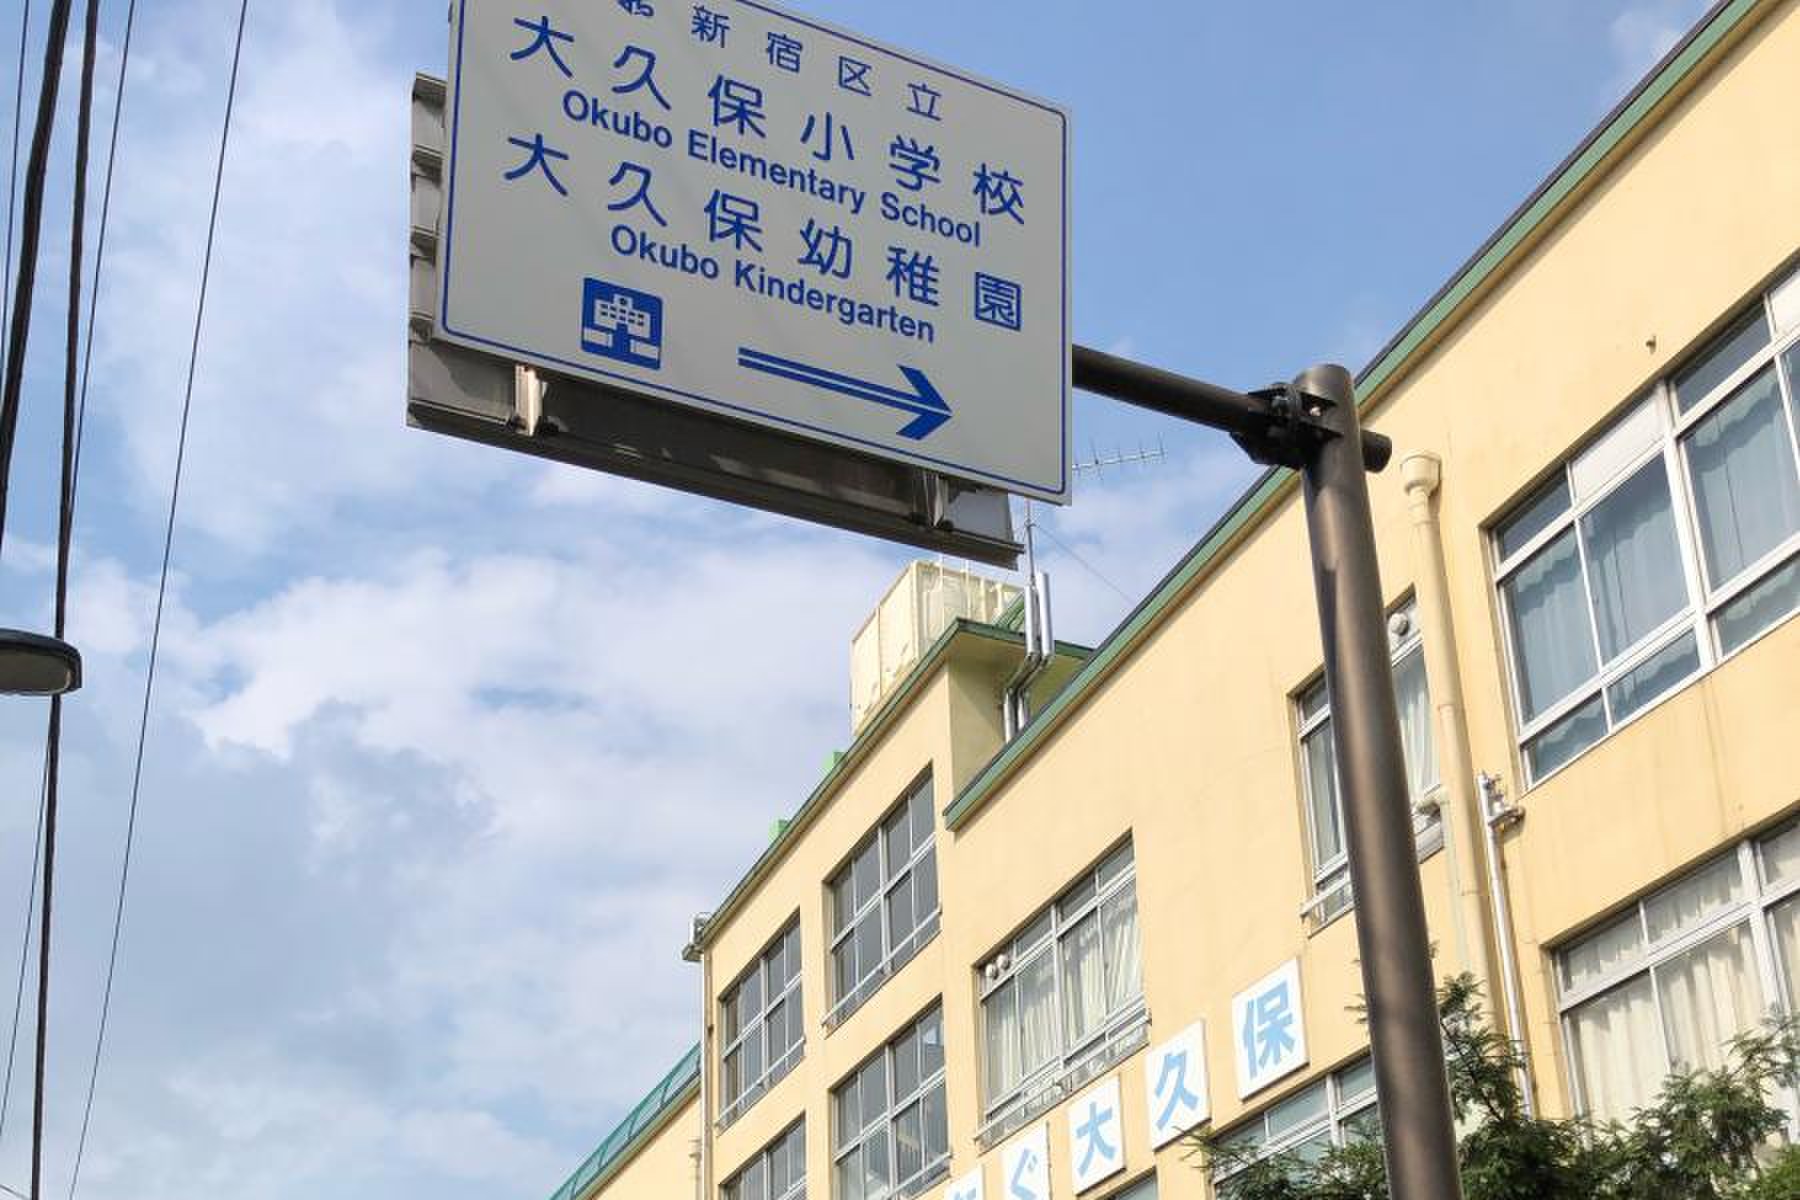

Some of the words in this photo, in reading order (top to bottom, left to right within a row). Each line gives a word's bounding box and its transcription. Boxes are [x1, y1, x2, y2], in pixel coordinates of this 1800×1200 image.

[510, 16, 1025, 226] 大久保小学校
[691, 7, 942, 121] 新宿区立
[504, 134, 1023, 331] 大久保幼稚園
[562, 90, 673, 148] Okubo
[687, 129, 866, 214] Elementary
[881, 191, 981, 247] School
[611, 224, 719, 279] Okubo
[735, 262, 935, 343] Kindergarten
